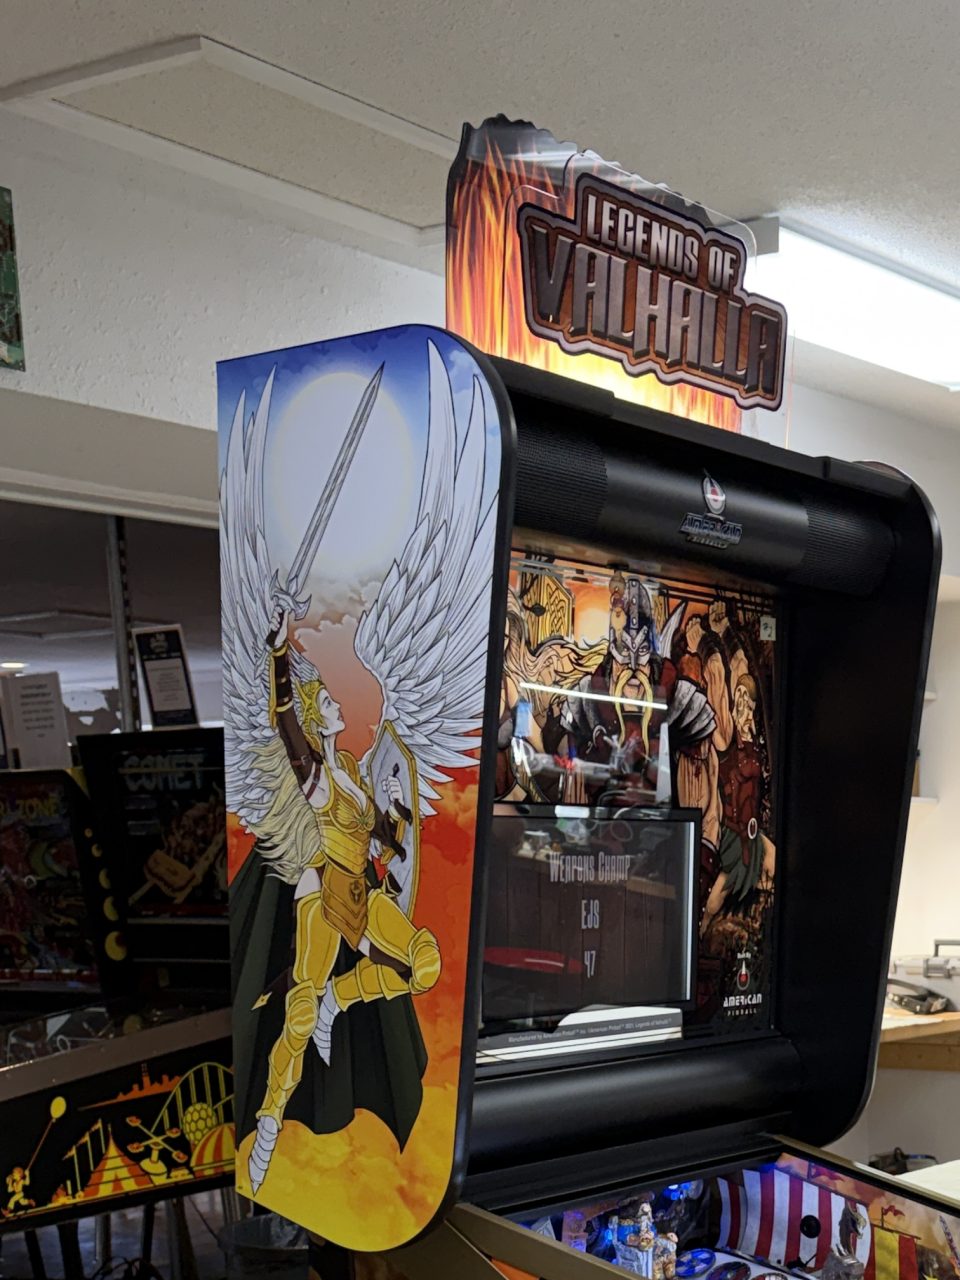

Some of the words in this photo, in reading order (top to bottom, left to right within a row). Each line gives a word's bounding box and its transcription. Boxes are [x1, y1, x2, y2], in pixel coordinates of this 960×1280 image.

[587, 193, 699, 279] LEGENDS
[708, 245, 739, 292] OF
[532, 225, 780, 396] VALHALLA
[123, 753, 205, 792] COMET
[581, 899, 600, 930] EJS
[584, 950, 596, 978] 47
[723, 993, 763, 1008] AMERICAN
